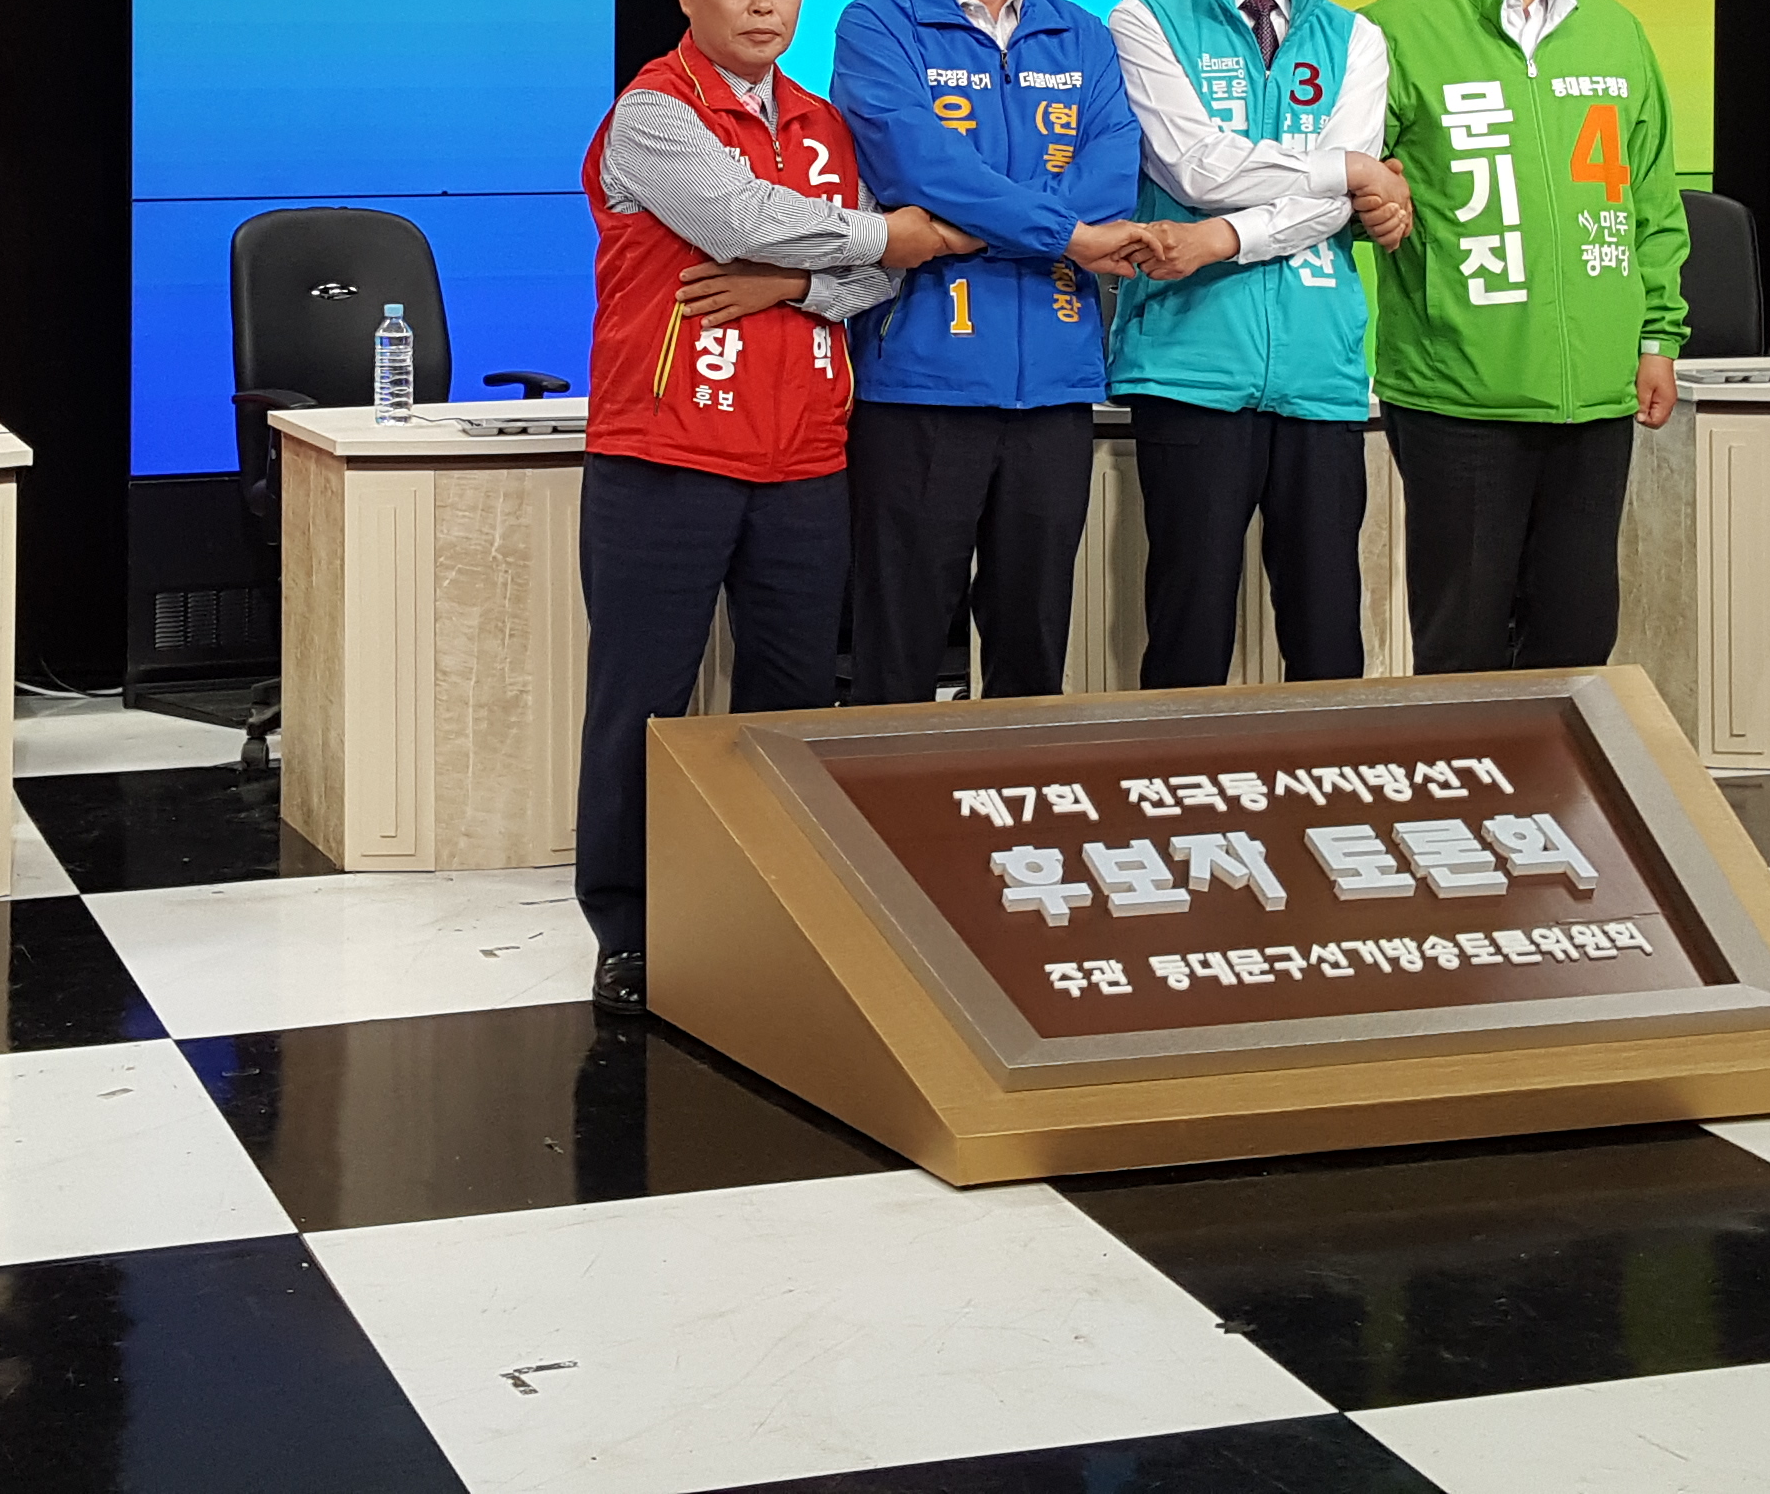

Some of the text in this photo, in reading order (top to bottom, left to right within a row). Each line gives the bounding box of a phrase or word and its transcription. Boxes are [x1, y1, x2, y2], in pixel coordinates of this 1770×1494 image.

[970, 72, 992, 90] 선거
[1289, 62, 1325, 107] 3
[1551, 76, 1629, 99] 동대문구청장
[802, 138, 841, 187] 2
[1570, 104, 1631, 204] 4
[1440, 80, 1528, 306] 문기진
[1599, 210, 1629, 243] 민주
[1581, 243, 1630, 277] 평화당
[949, 279, 976, 336] 1
[692, 384, 735, 412] 후보
[953, 757, 1516, 828] 제7회 전국동시지방선거
[990, 813, 1600, 927] 후보자 토론회
[1043, 921, 1654, 998] 주관 동대문구선거방송토론위원회
